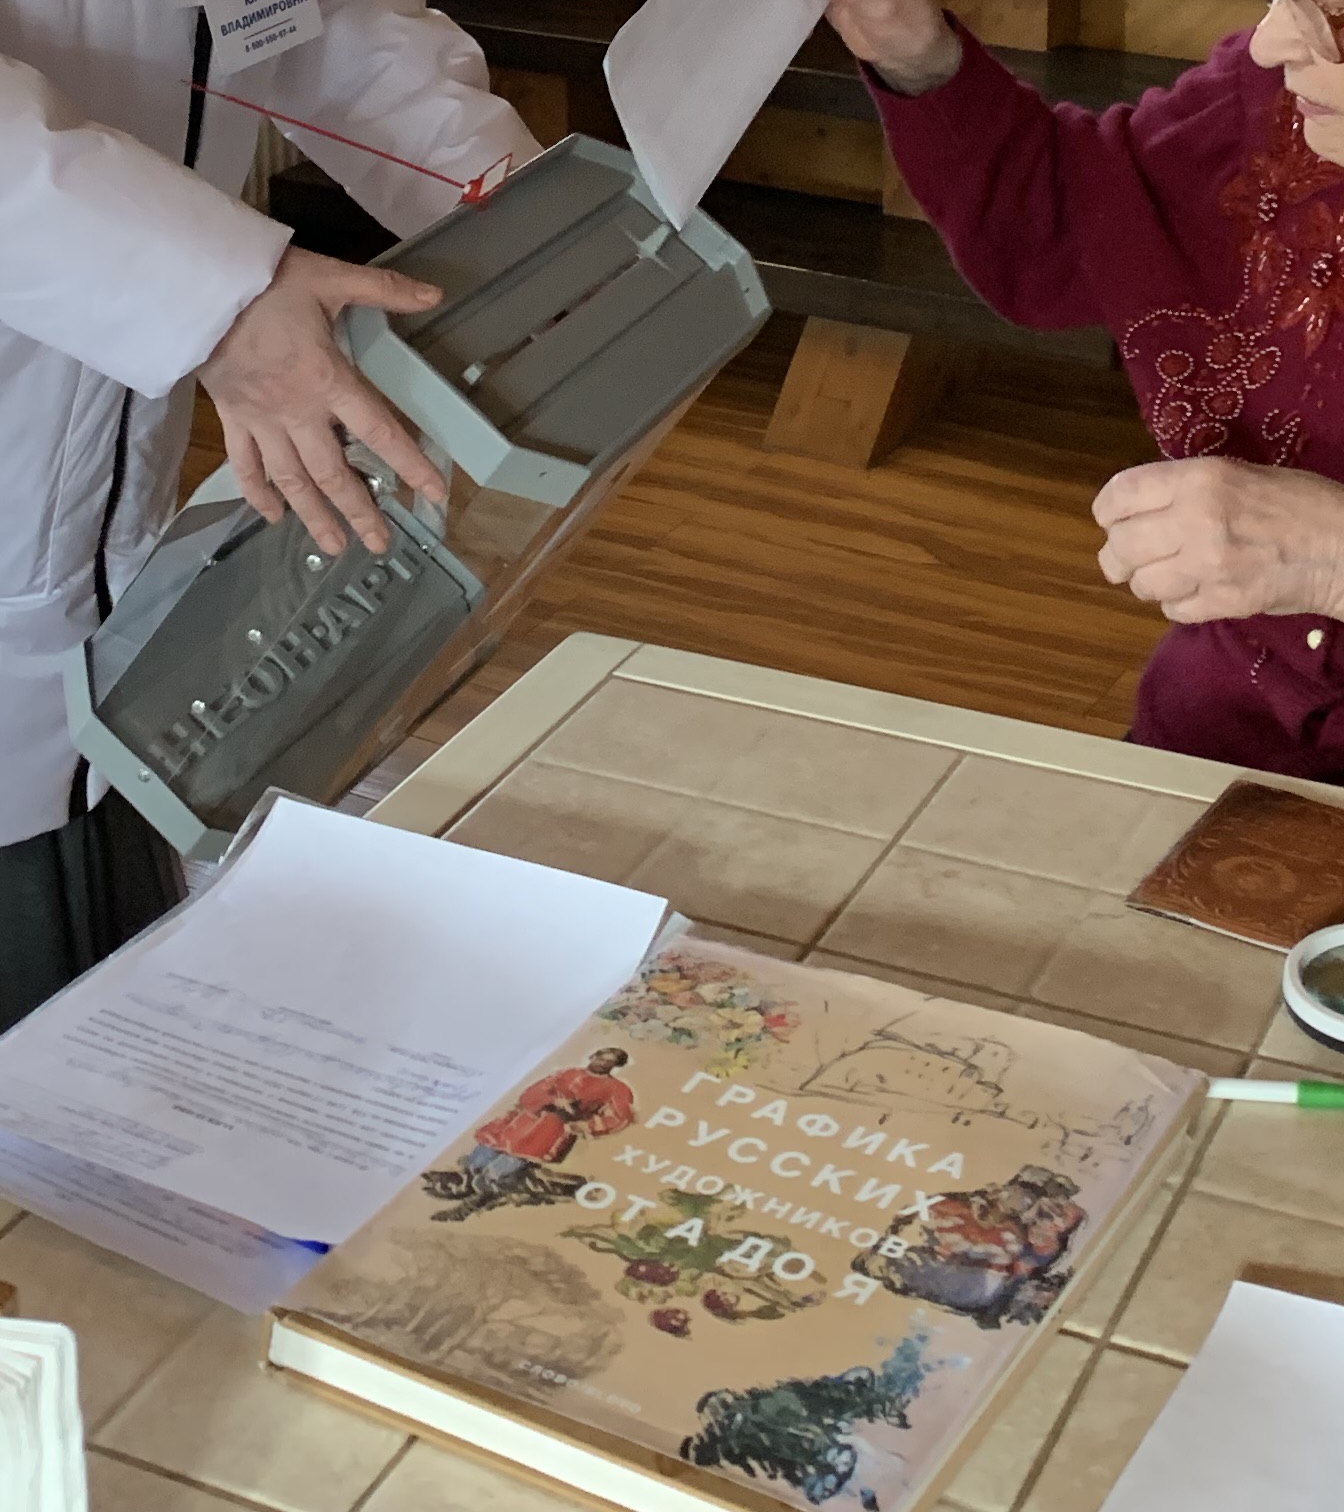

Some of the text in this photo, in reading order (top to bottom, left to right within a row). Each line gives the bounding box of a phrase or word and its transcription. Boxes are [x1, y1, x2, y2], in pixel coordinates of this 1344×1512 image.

[644, 1105, 946, 1222] РУССКИХ
[681, 1070, 967, 1180] ГРАФИКА
[574, 1180, 881, 1306] ОТ А ДО Я
[612, 1144, 909, 1260] ХУДОЖНИКОВ
